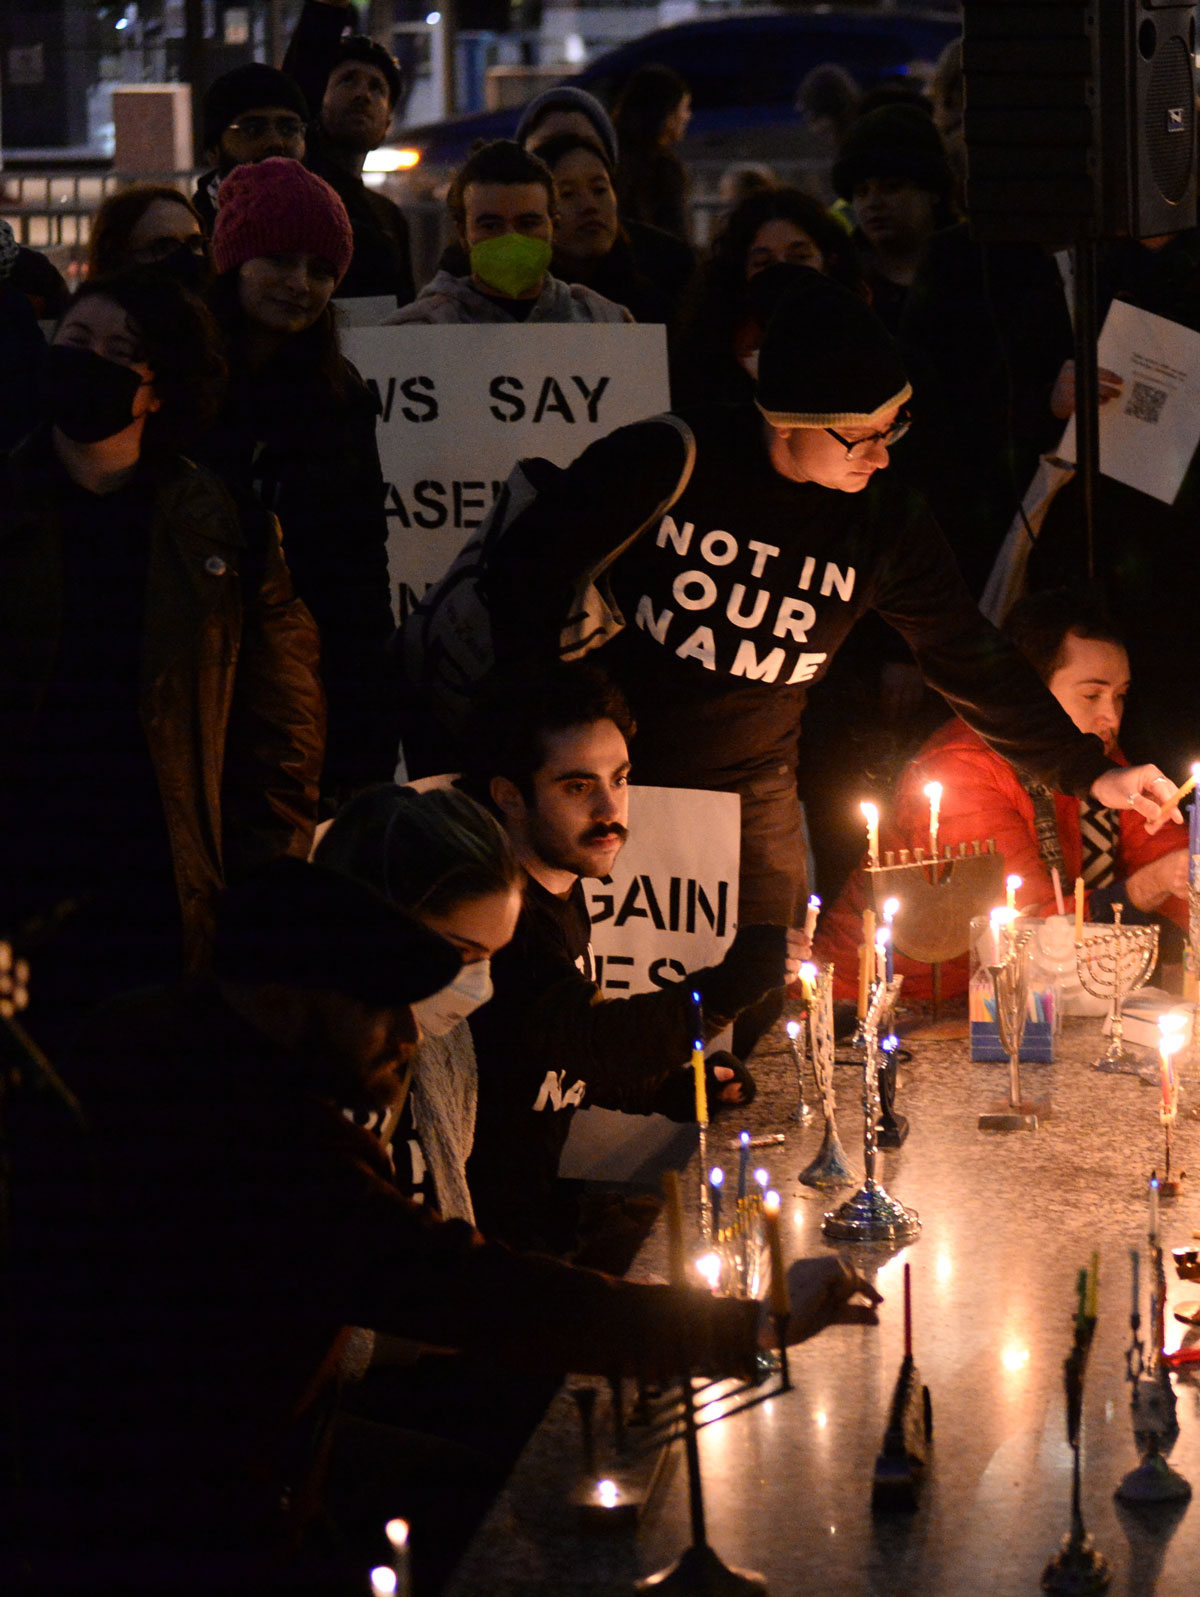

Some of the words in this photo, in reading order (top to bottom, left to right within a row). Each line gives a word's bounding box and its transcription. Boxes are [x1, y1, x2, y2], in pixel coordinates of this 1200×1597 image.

[489, 375, 610, 423] SAY
[655, 514, 781, 579] NOT
[798, 555, 856, 602] IN
[634, 593, 828, 685] NAME
[672, 569, 817, 643] OUR
[591, 874, 728, 937] GAIN
